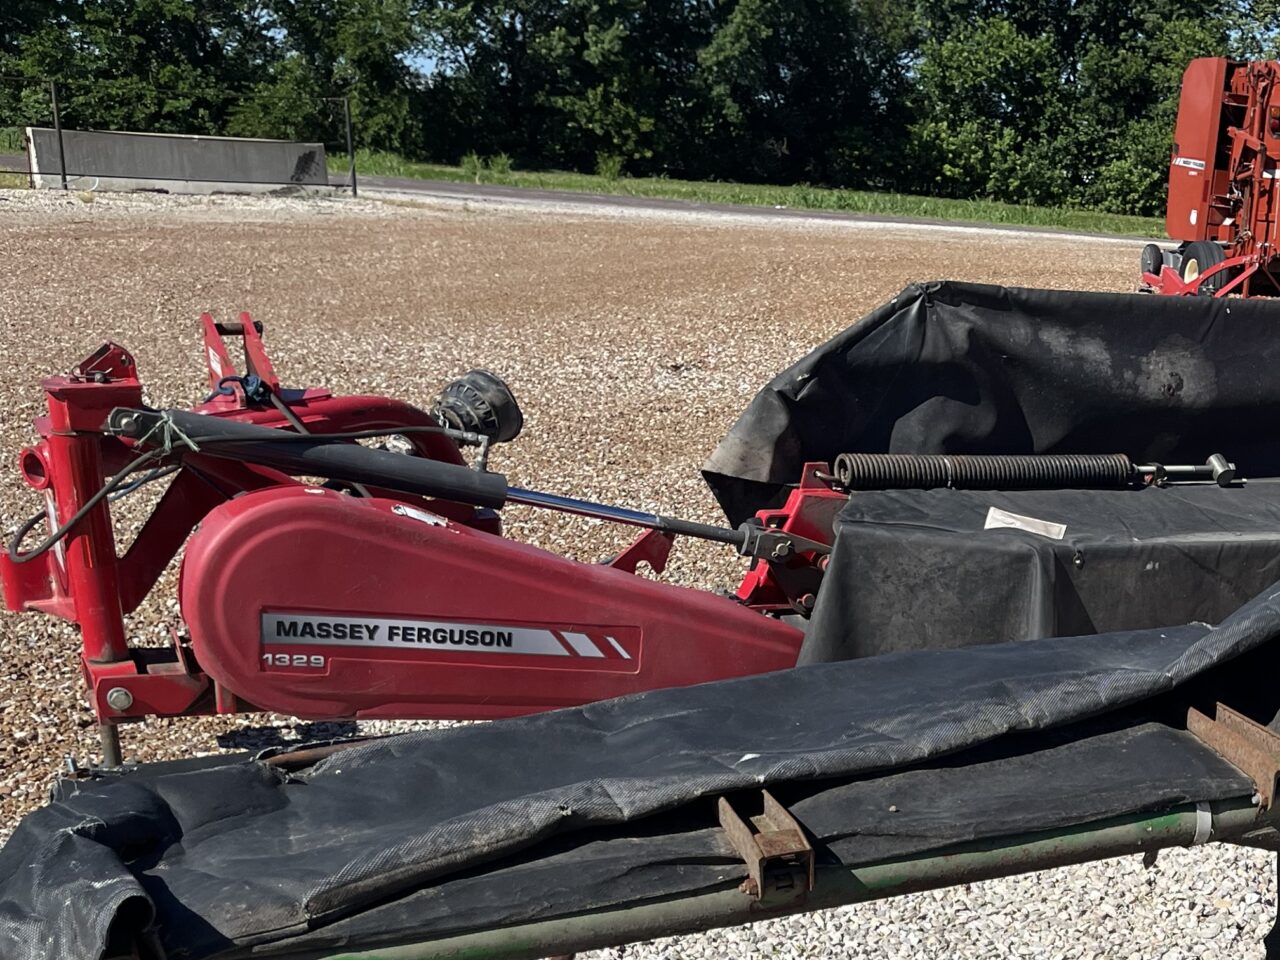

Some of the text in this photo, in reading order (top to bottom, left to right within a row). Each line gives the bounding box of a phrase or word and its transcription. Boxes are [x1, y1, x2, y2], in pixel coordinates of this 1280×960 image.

[276, 620, 513, 648] MASSEY FERGUSON
[262, 653, 325, 667] 1329
